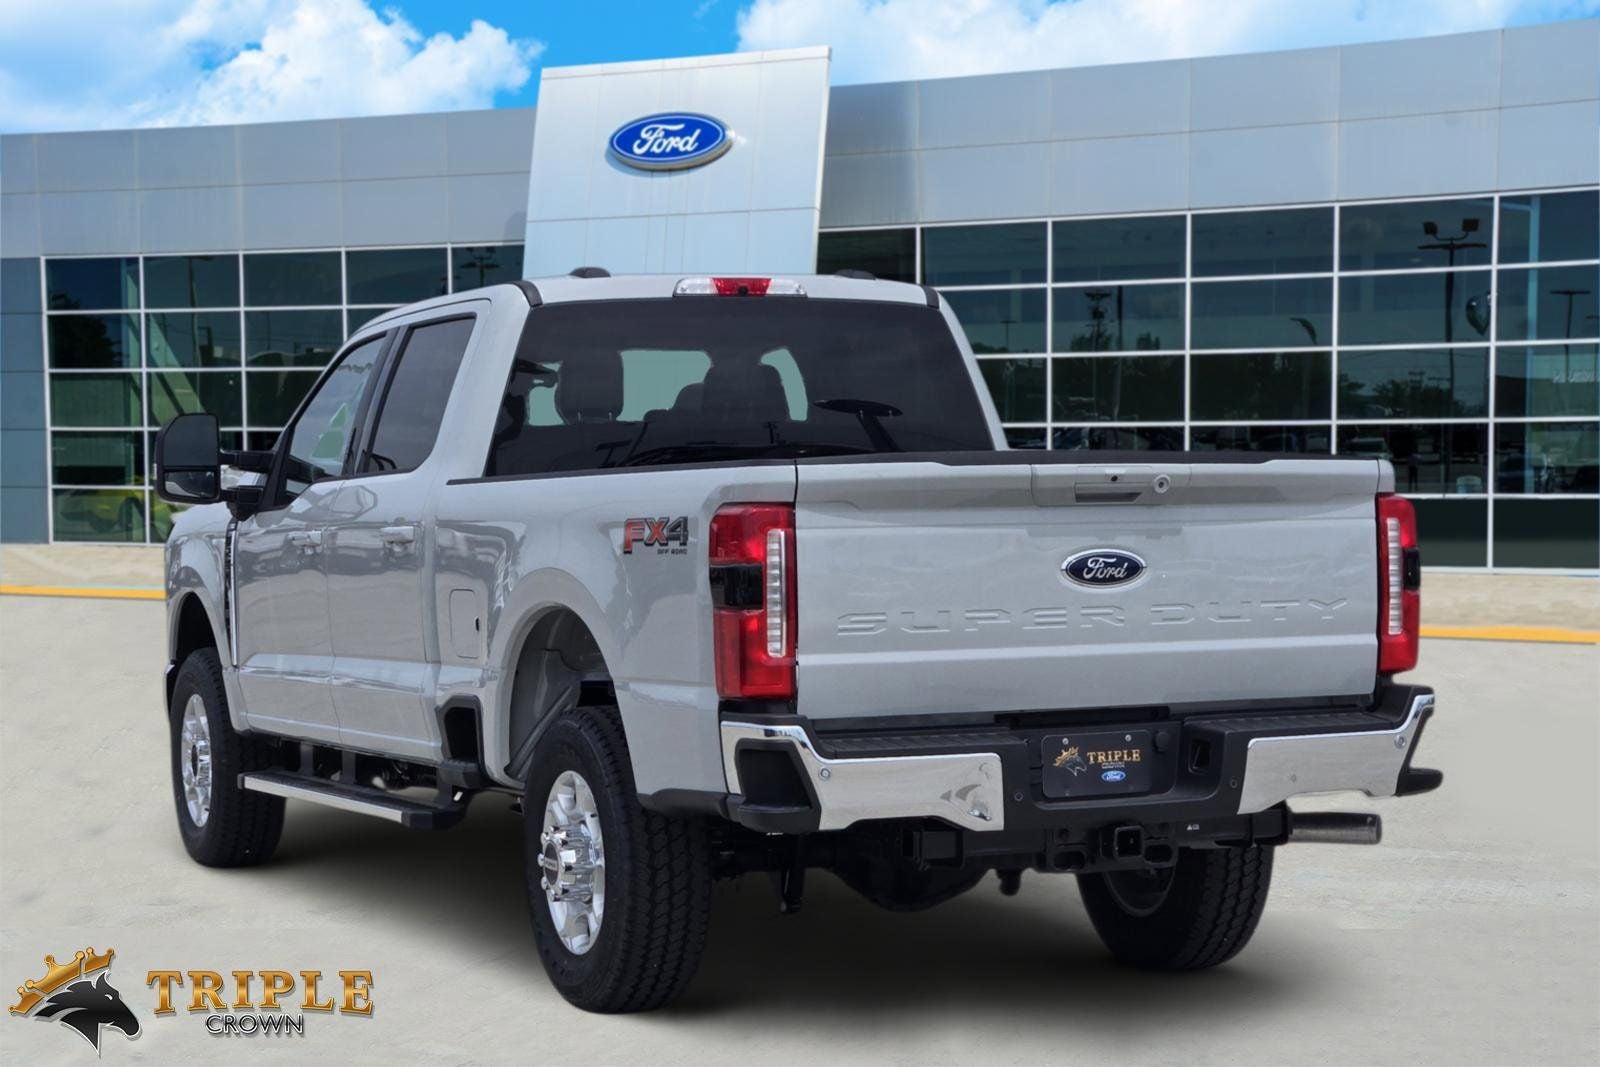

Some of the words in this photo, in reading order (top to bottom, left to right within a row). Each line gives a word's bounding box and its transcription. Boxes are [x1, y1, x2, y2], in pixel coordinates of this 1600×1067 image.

[632, 123, 701, 155] Ford
[623, 516, 689, 554] FX4
[1082, 557, 1128, 579] Ford
[836, 607, 1126, 636] SUPER
[1149, 598, 1347, 626] DUTY
[1087, 749, 1141, 764] TRIPLE
